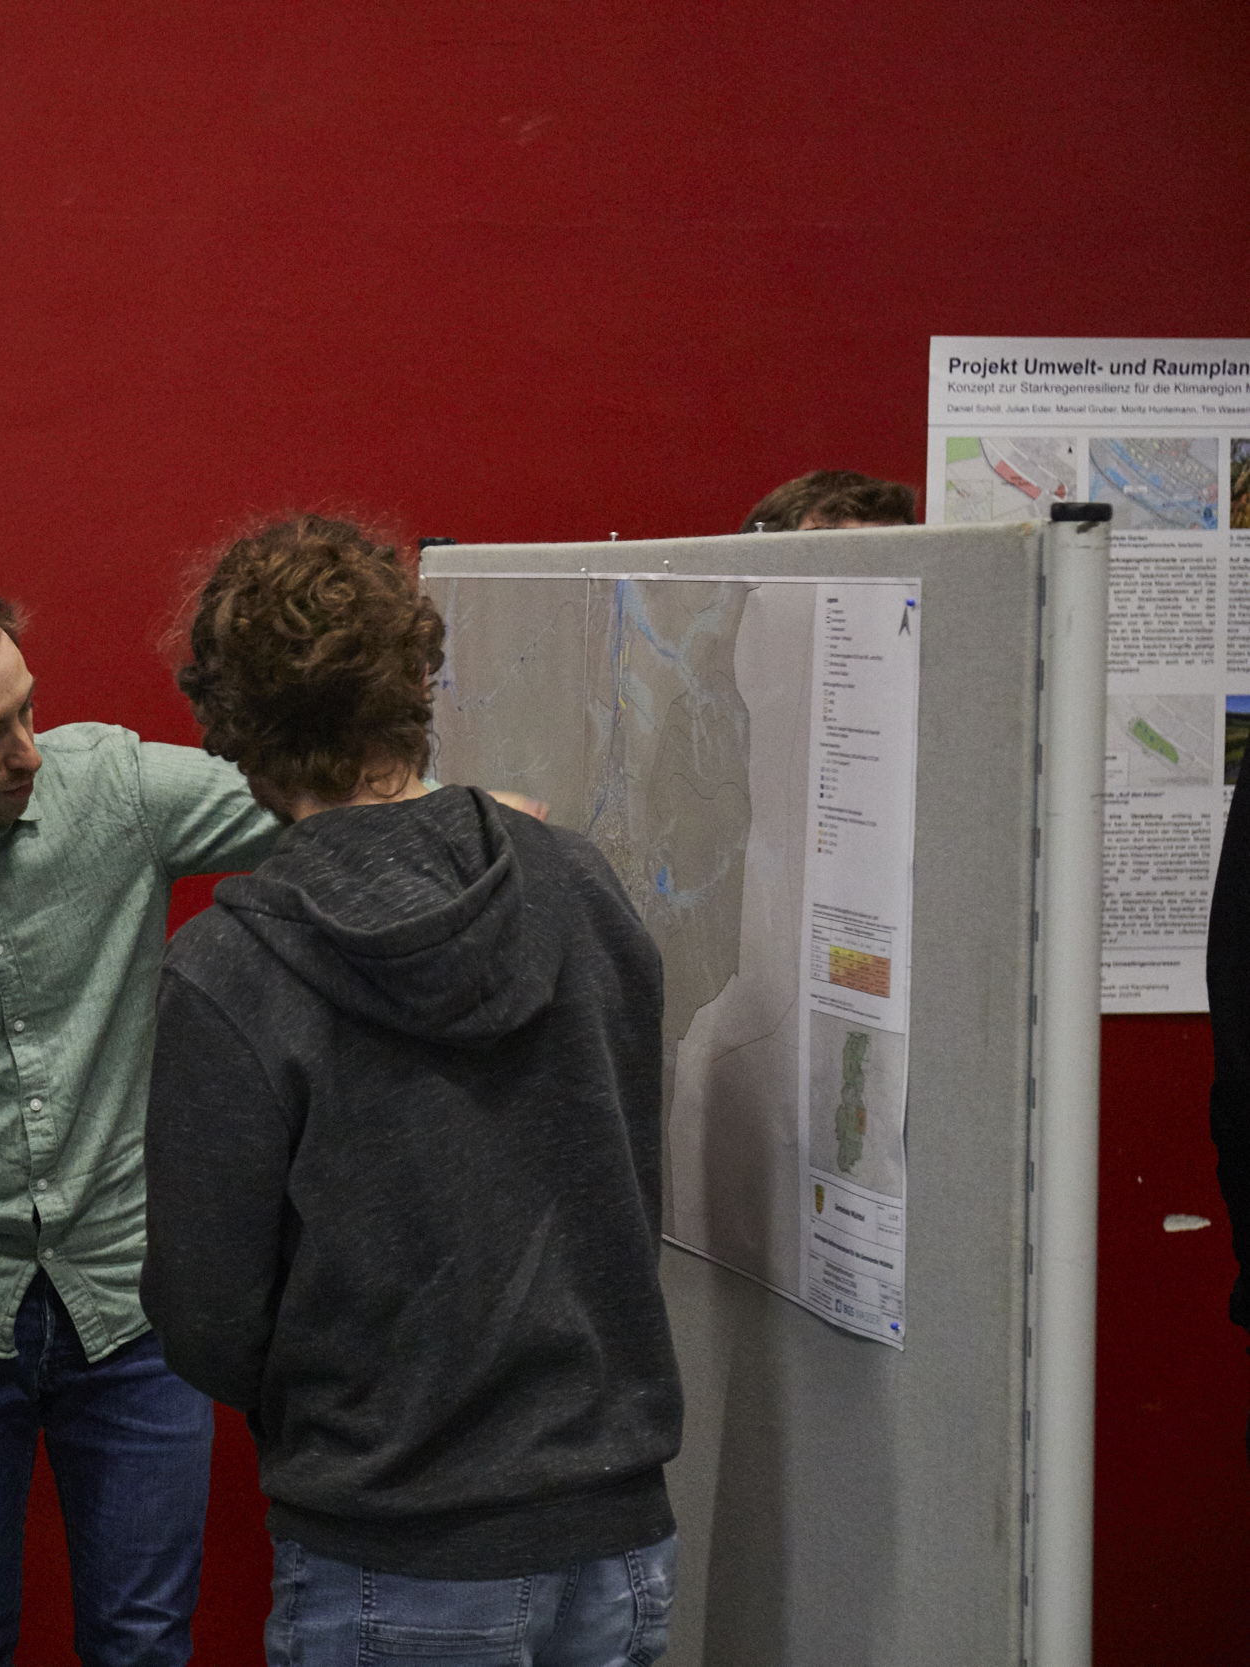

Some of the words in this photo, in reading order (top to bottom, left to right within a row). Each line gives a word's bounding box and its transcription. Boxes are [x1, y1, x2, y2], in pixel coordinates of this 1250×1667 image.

[948, 357, 1018, 378] Projekt
[1024, 358, 1103, 375] Umwelt-
[1110, 358, 1146, 375] und
[947, 382, 995, 394] Konzept
[999, 383, 1016, 393] zur
[1020, 382, 1130, 395] Starkregenresilienz
[1134, 382, 1149, 393] für
[1153, 383, 1170, 393] die
[1174, 383, 1242, 396] Klimaregion
